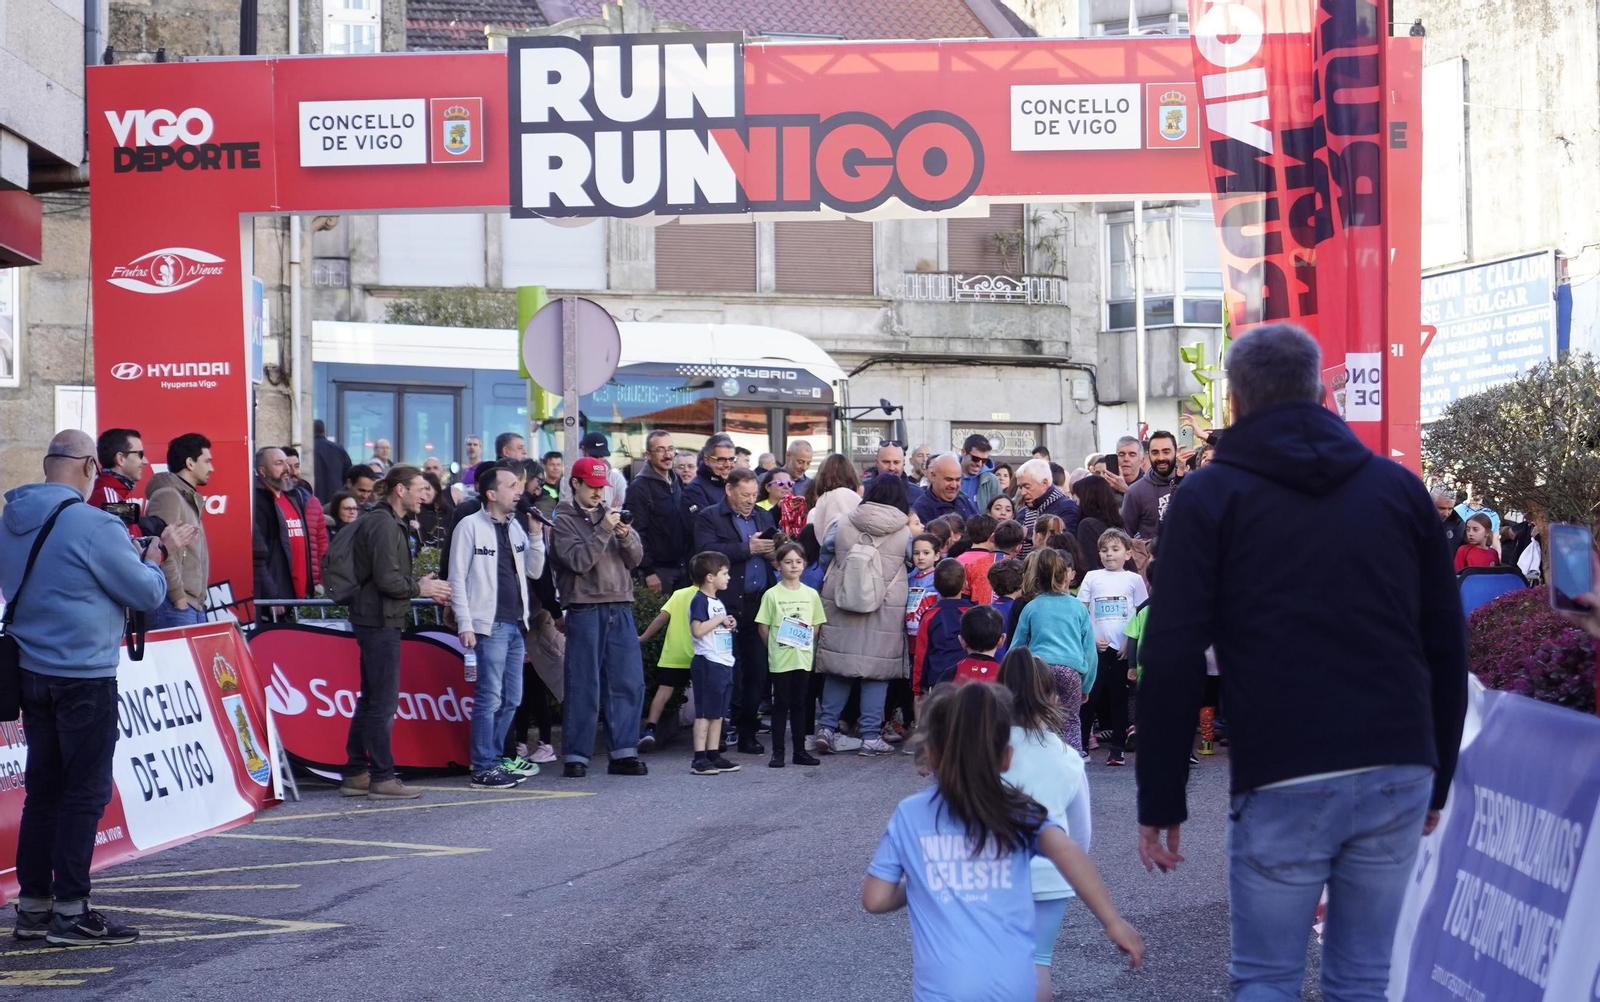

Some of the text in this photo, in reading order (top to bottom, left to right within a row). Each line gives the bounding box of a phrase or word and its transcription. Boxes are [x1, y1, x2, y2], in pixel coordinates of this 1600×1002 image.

[519, 42, 736, 123] RUN
[1020, 98, 1130, 115] CONCELLO
[104, 107, 213, 148] VIGO
[309, 113, 415, 131] CONCELLO
[1034, 119, 1117, 135] DE VIGO
[322, 134, 403, 151] DE VIGO
[113, 142, 261, 173] DEPORTE
[111, 263, 224, 278] Frutas Nieves
[1465, 270, 1483, 294] DE
[1486, 257, 1549, 290] CALZADO
[147, 362, 230, 377] HYUNDAI
[736, 368, 797, 380] HYBRID
[160, 380, 217, 390] Hyupersa Vigo
[1101, 604, 1120, 613] 1031
[788, 627, 807, 640] 1024
[130, 740, 214, 802] DE VIGO
[925, 859, 1013, 891] CELESTE
